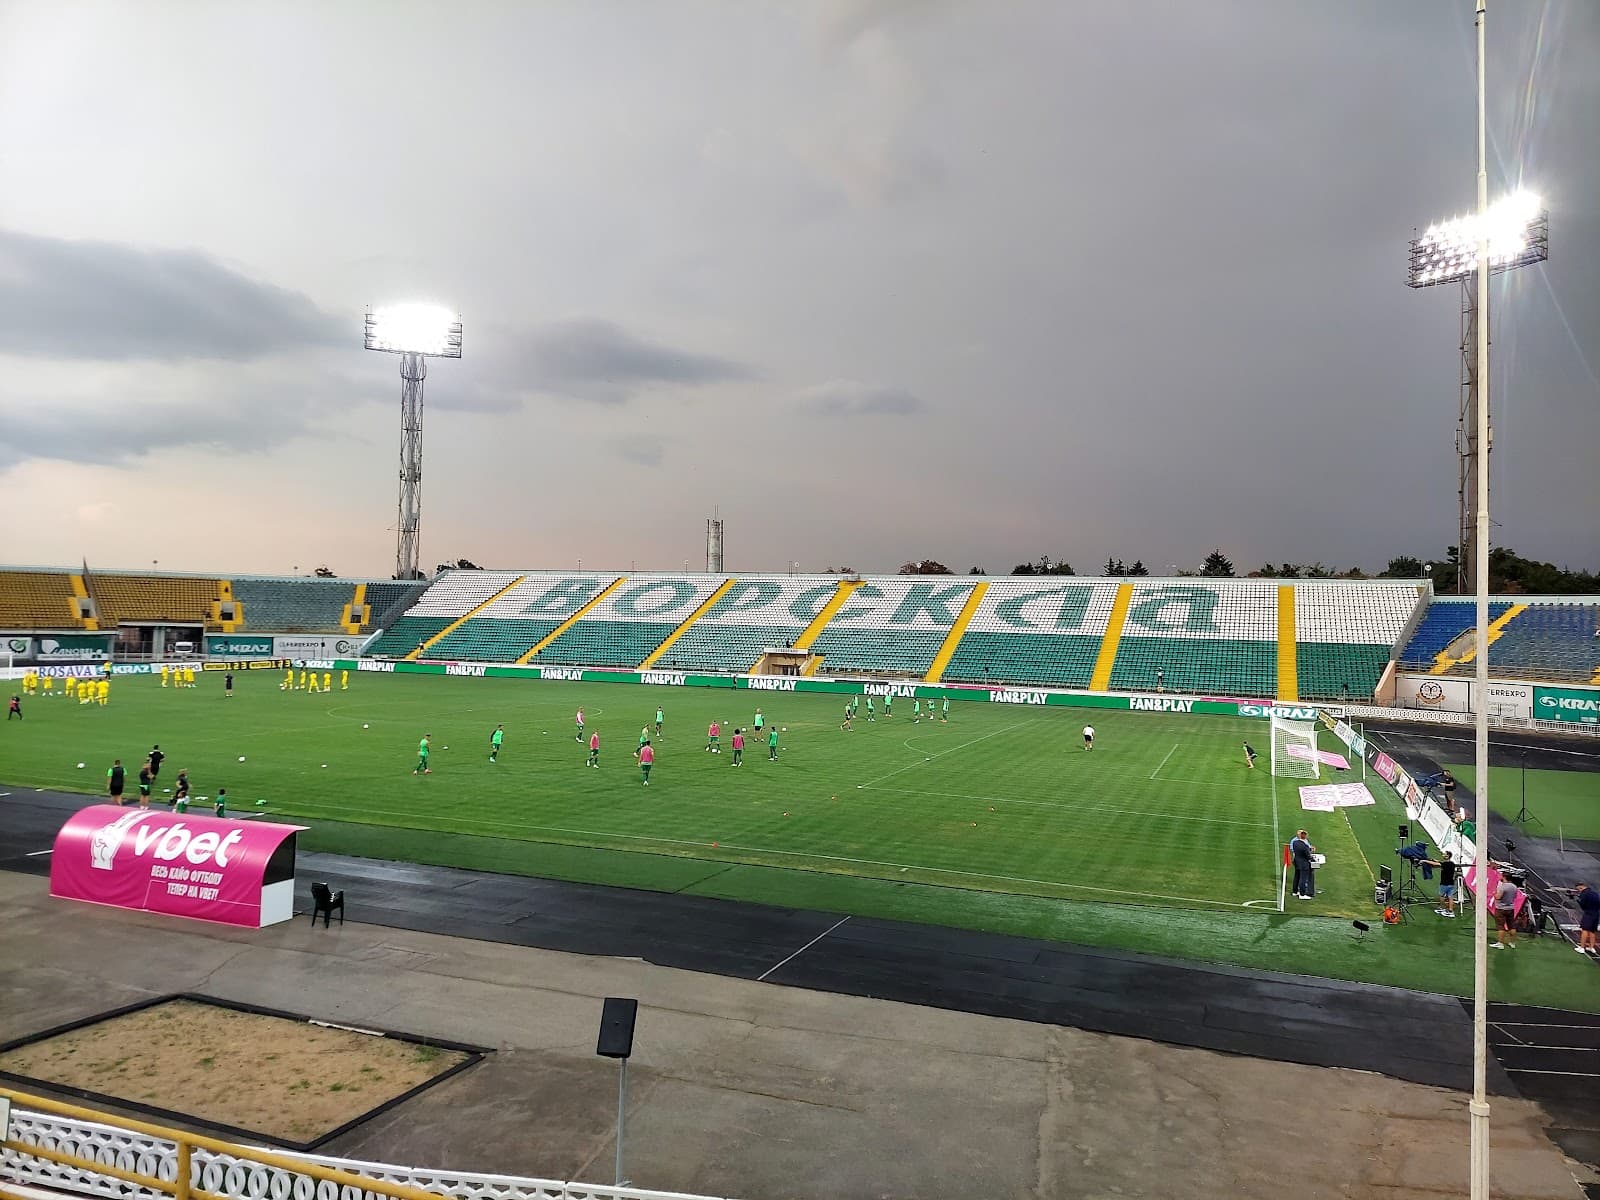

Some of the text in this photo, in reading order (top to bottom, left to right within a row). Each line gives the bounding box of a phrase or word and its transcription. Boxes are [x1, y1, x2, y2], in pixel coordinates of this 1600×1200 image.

[229, 644, 270, 653] KRAZ
[112, 665, 151, 674] KRAZ
[305, 660, 336, 669] KRAZ
[357, 661, 396, 672] FAN&PLAY
[446, 665, 486, 677] FAN&PLAY
[39, 666, 93, 677] ROSAVA
[540, 669, 583, 681] FAN&PLAY
[640, 673, 686, 686] FAN&PLAY
[748, 678, 797, 691] FAN&PLAY
[863, 683, 917, 697] FAN&PLAY
[1487, 688, 1527, 698] ERREXPO
[989, 691, 1049, 704] FAN&PLAY
[1129, 697, 1194, 713] FAN&PLAY
[1262, 706, 1317, 719] KRAZ
[134, 823, 244, 868] vbet
[151, 865, 224, 885] ВЕСЬ КАЙФ ФУТБОЛУ
[167, 882, 188, 896] ТЕПЕР
[187, 885, 199, 898] НА
